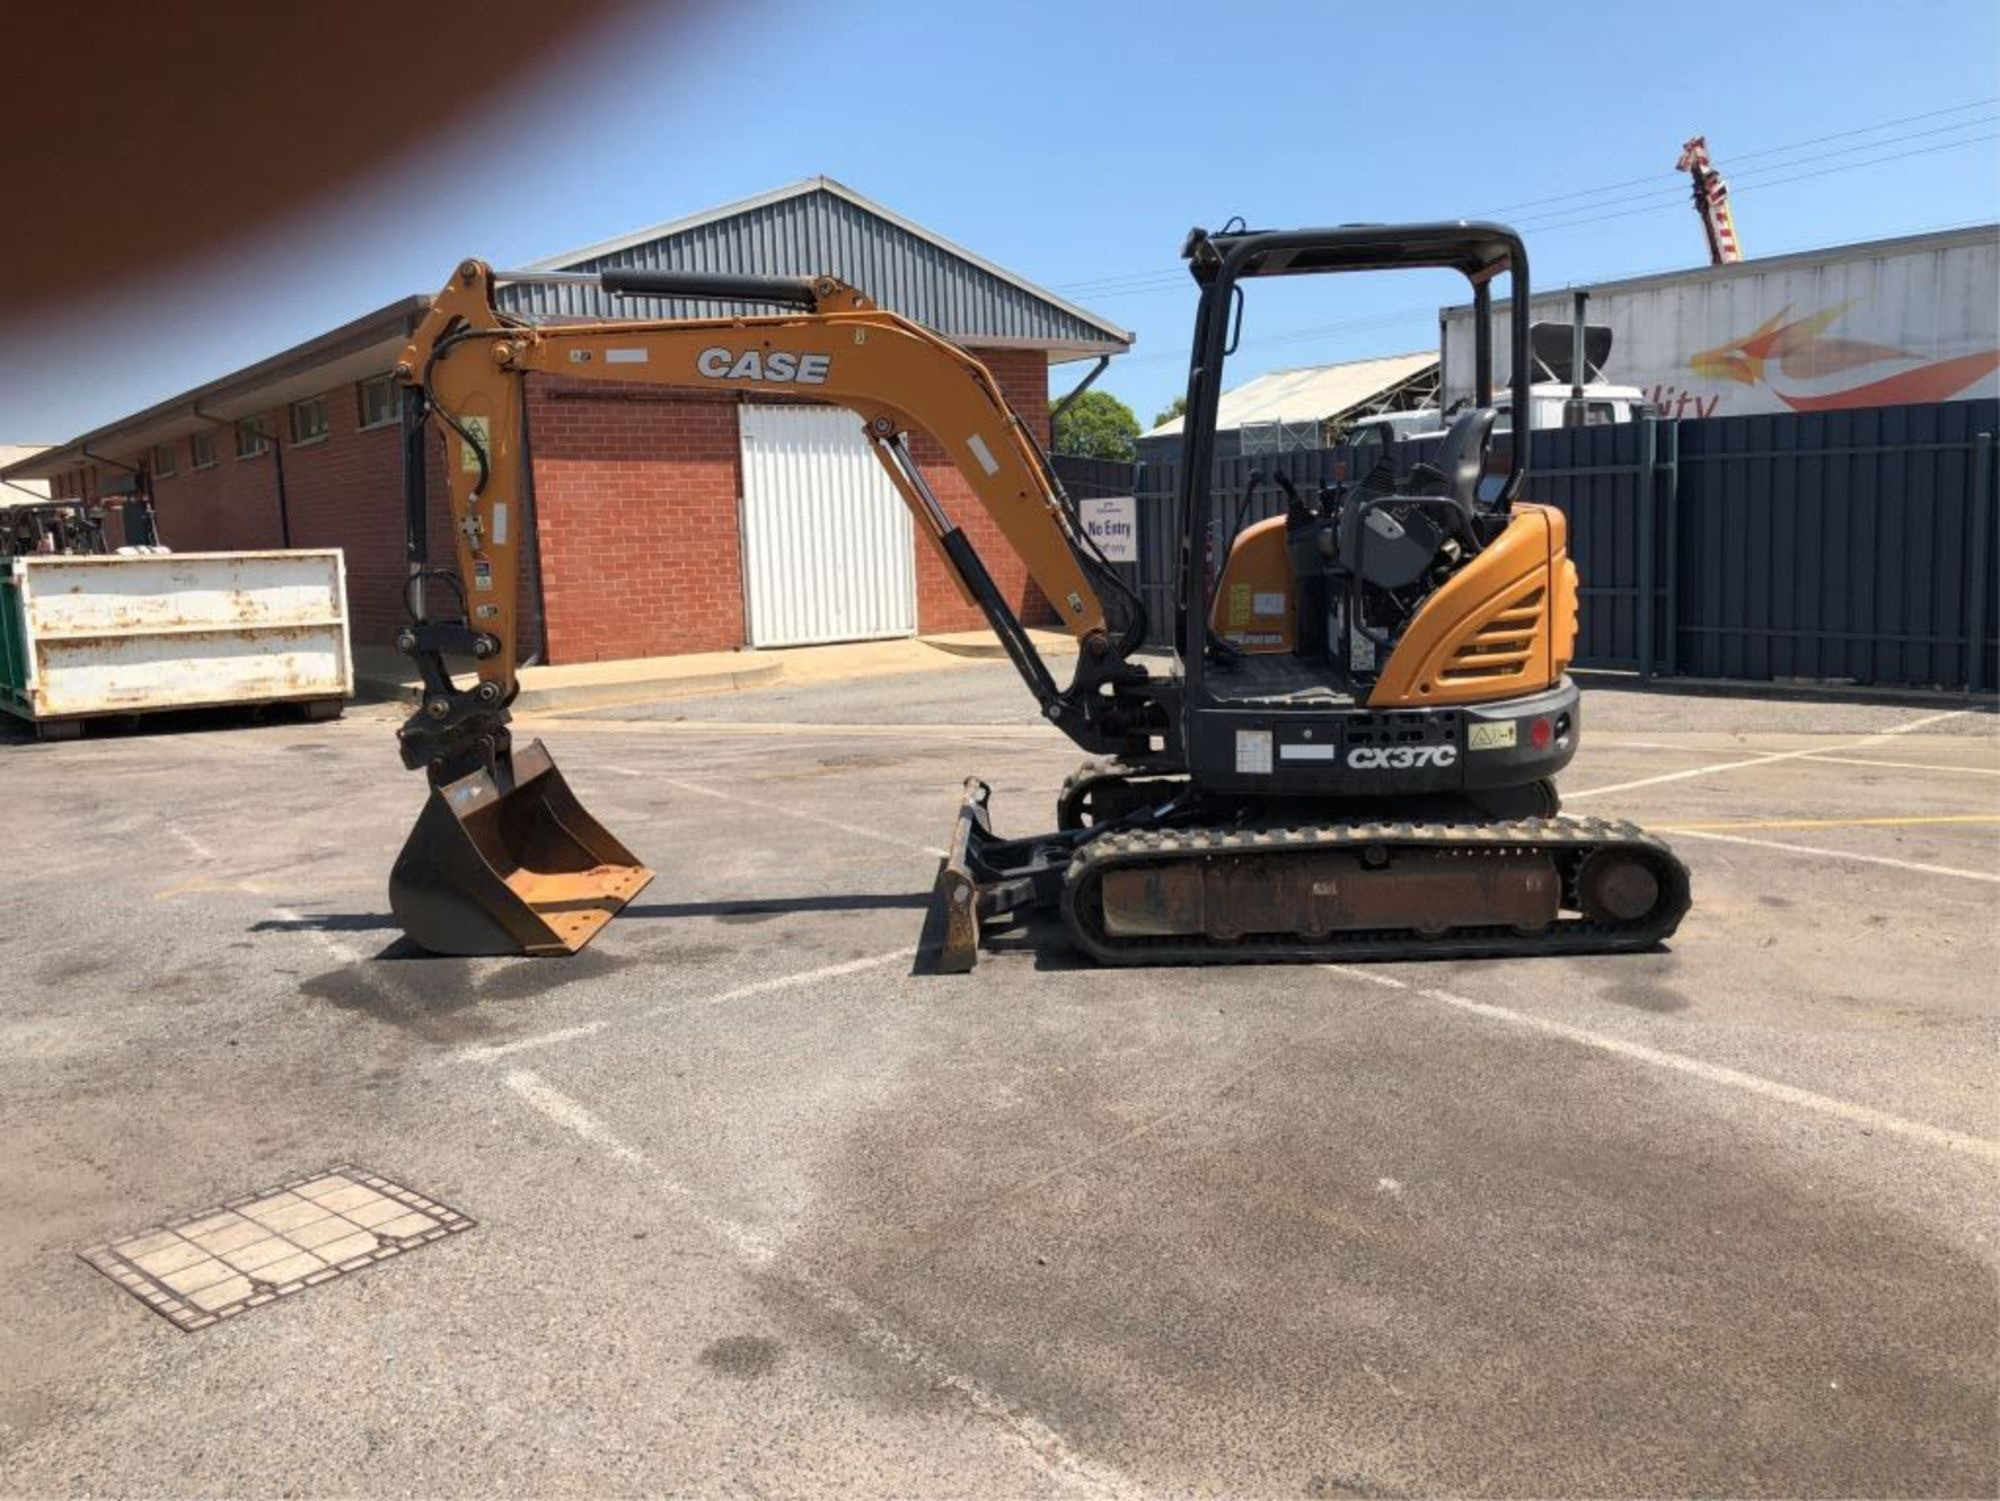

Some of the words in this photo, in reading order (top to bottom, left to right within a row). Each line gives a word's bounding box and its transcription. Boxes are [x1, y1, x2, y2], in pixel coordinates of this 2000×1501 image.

[697, 346, 831, 385] CASE
[1642, 384, 1719, 420] lity
[1088, 520, 1103, 536] No
[1104, 520, 1130, 538] Entry
[1347, 745, 1457, 769] CX37C
